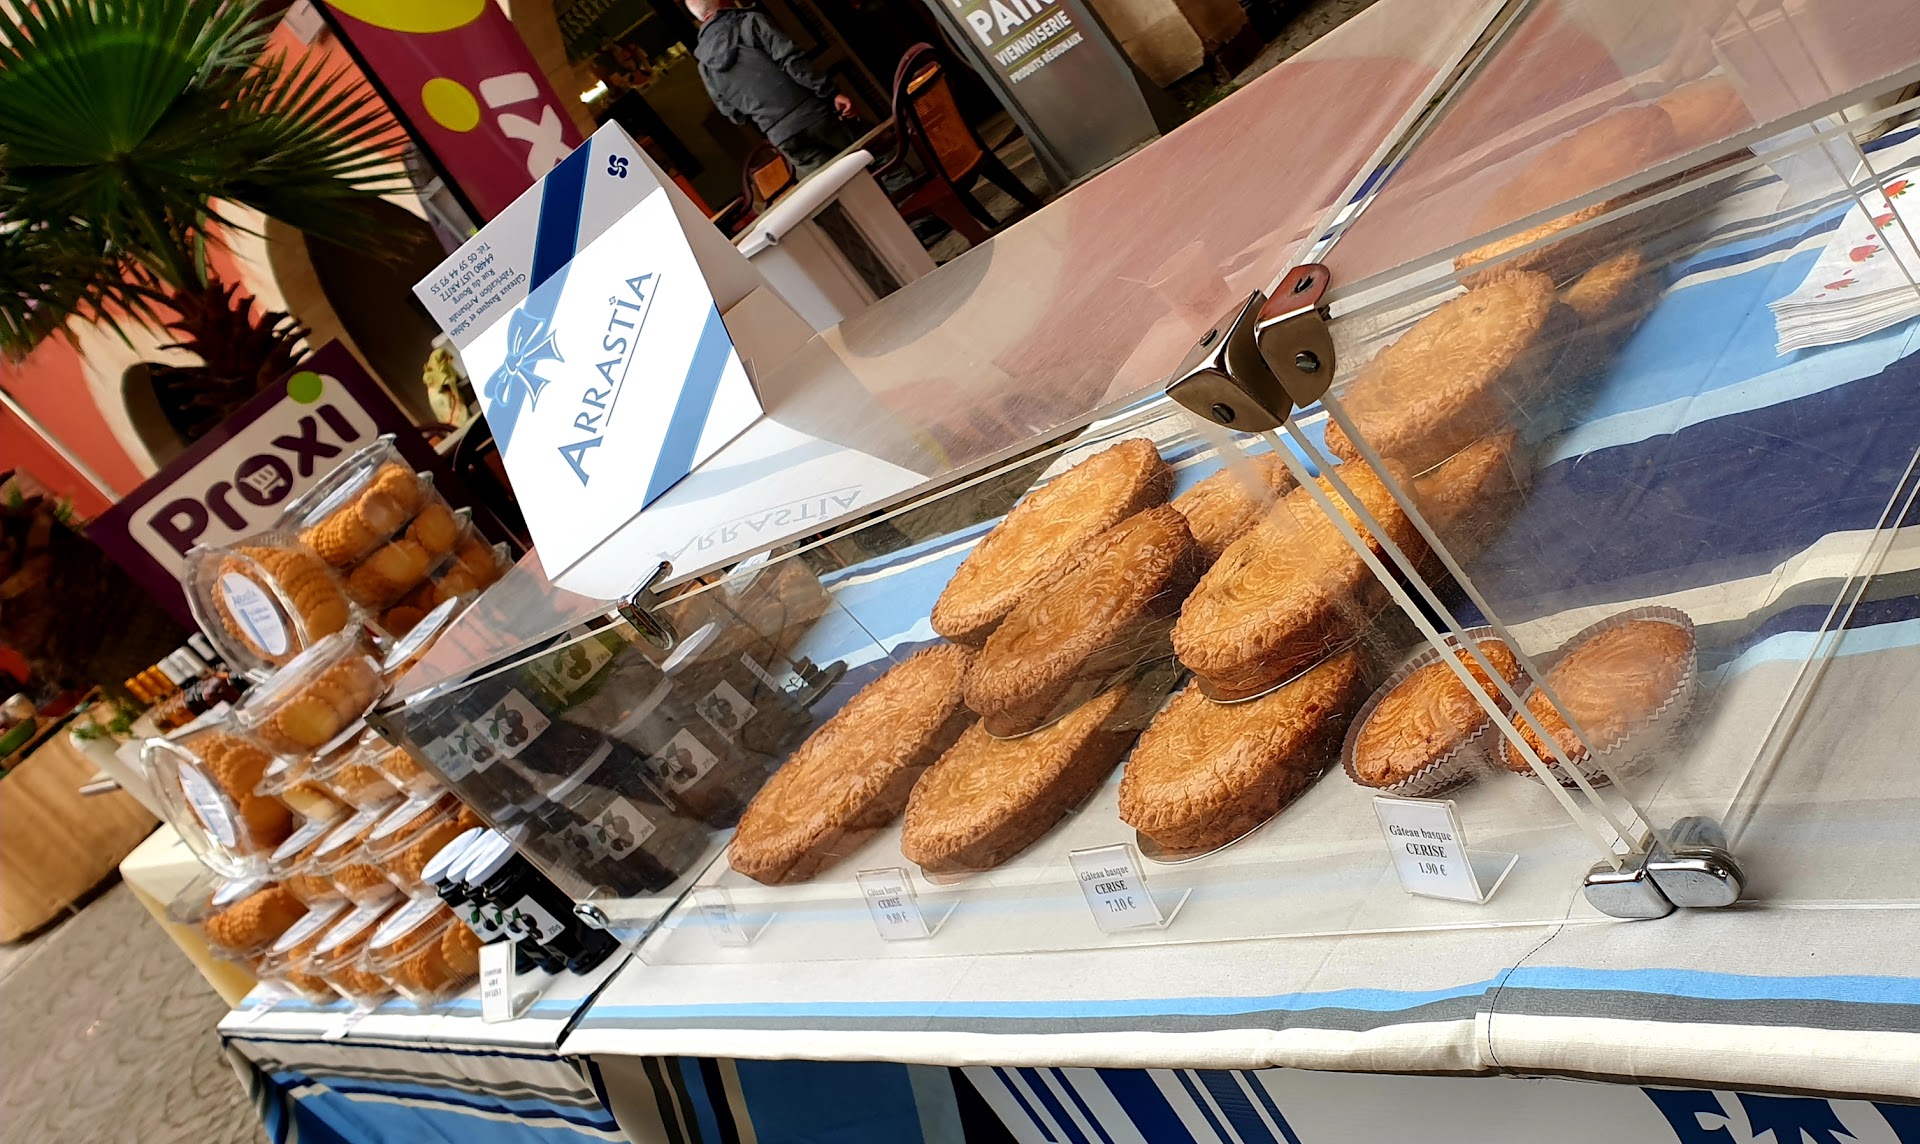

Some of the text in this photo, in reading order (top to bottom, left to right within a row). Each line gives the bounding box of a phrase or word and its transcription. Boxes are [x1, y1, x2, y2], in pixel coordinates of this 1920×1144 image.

[994, 10, 1072, 67] VIENNOISERIE
[1009, 56, 1045, 84] PRODUITS
[467, 252, 478, 261] 05
[473, 253, 494, 273] 64480
[459, 260, 468, 271] 59
[440, 275, 449, 287] 93
[448, 268, 459, 279] 44
[430, 283, 440, 295] 55
[452, 269, 496, 304] Rue du Bourg
[448, 267, 515, 323] Fabrication Artisanale
[477, 293, 501, 315] Basques
[1389, 825, 1452, 842] Gâteau basque
[1406, 842, 1447, 858] CERISE
[1081, 866, 1129, 881] Gâteau basque
[1418, 862, 1448, 876] 1.90 €
[1095, 880, 1128, 895] CERISE
[878, 897, 902, 909] CERISE
[1106, 896, 1136, 912] 7.10 €
